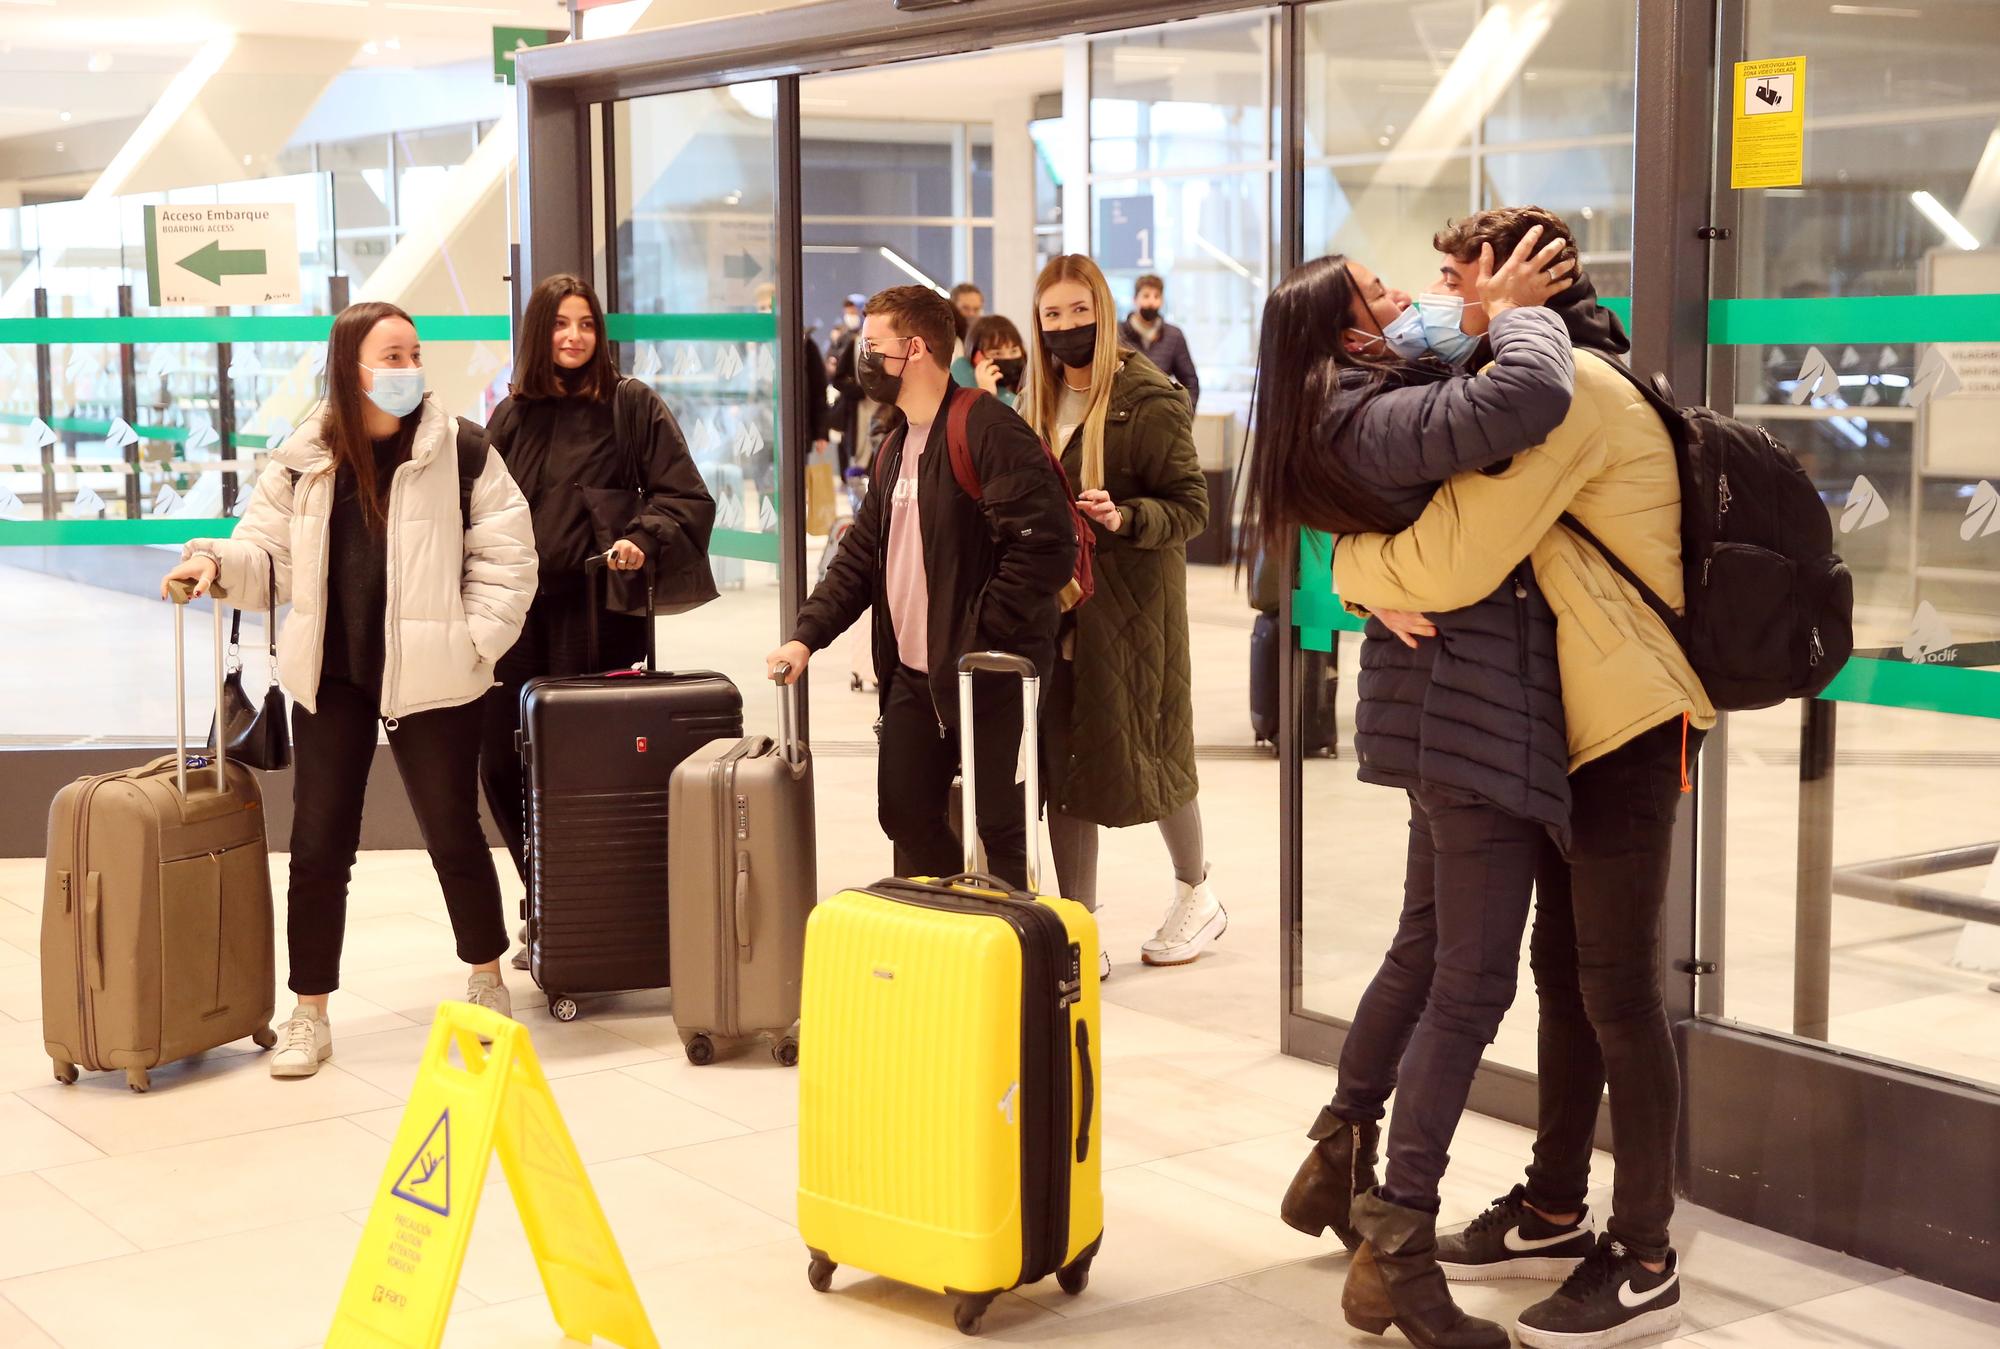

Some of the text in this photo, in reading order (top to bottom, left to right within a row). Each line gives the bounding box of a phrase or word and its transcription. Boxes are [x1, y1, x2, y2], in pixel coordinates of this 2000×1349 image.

[162, 209, 270, 222] Acceso Embarque
[162, 225, 235, 233] BOARDING ACCESS
[1136, 228, 1153, 267] 1
[1927, 648, 1959, 662] adif
